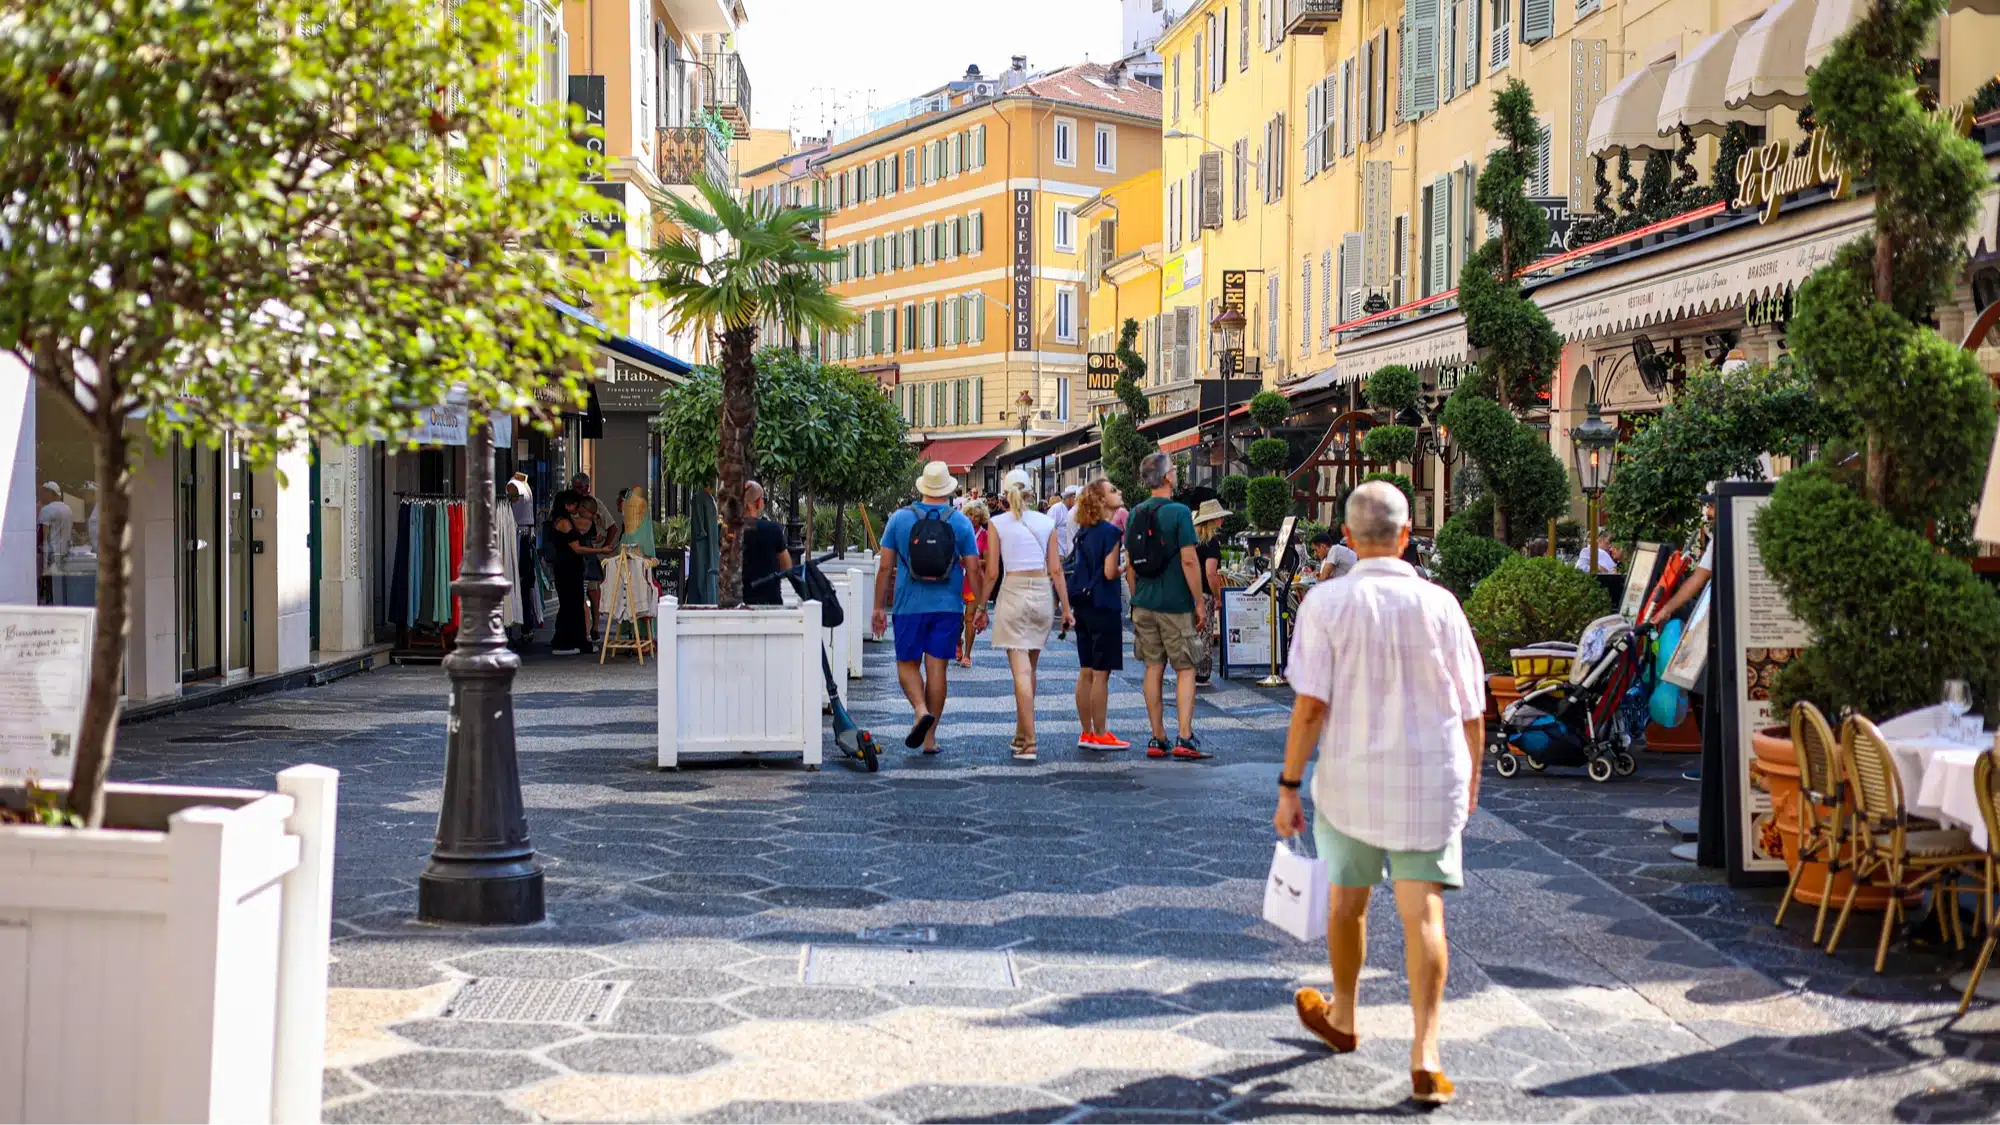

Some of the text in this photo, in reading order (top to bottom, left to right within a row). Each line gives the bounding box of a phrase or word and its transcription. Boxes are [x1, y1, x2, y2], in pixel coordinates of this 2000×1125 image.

[1733, 147, 1757, 209] Le
[1759, 130, 1818, 225] Grand
[1015, 190, 1031, 349] HOTEL de SUEDE
[1627, 292, 1654, 308] RESTAURANT
[1747, 260, 1779, 280] BRASSERIE
